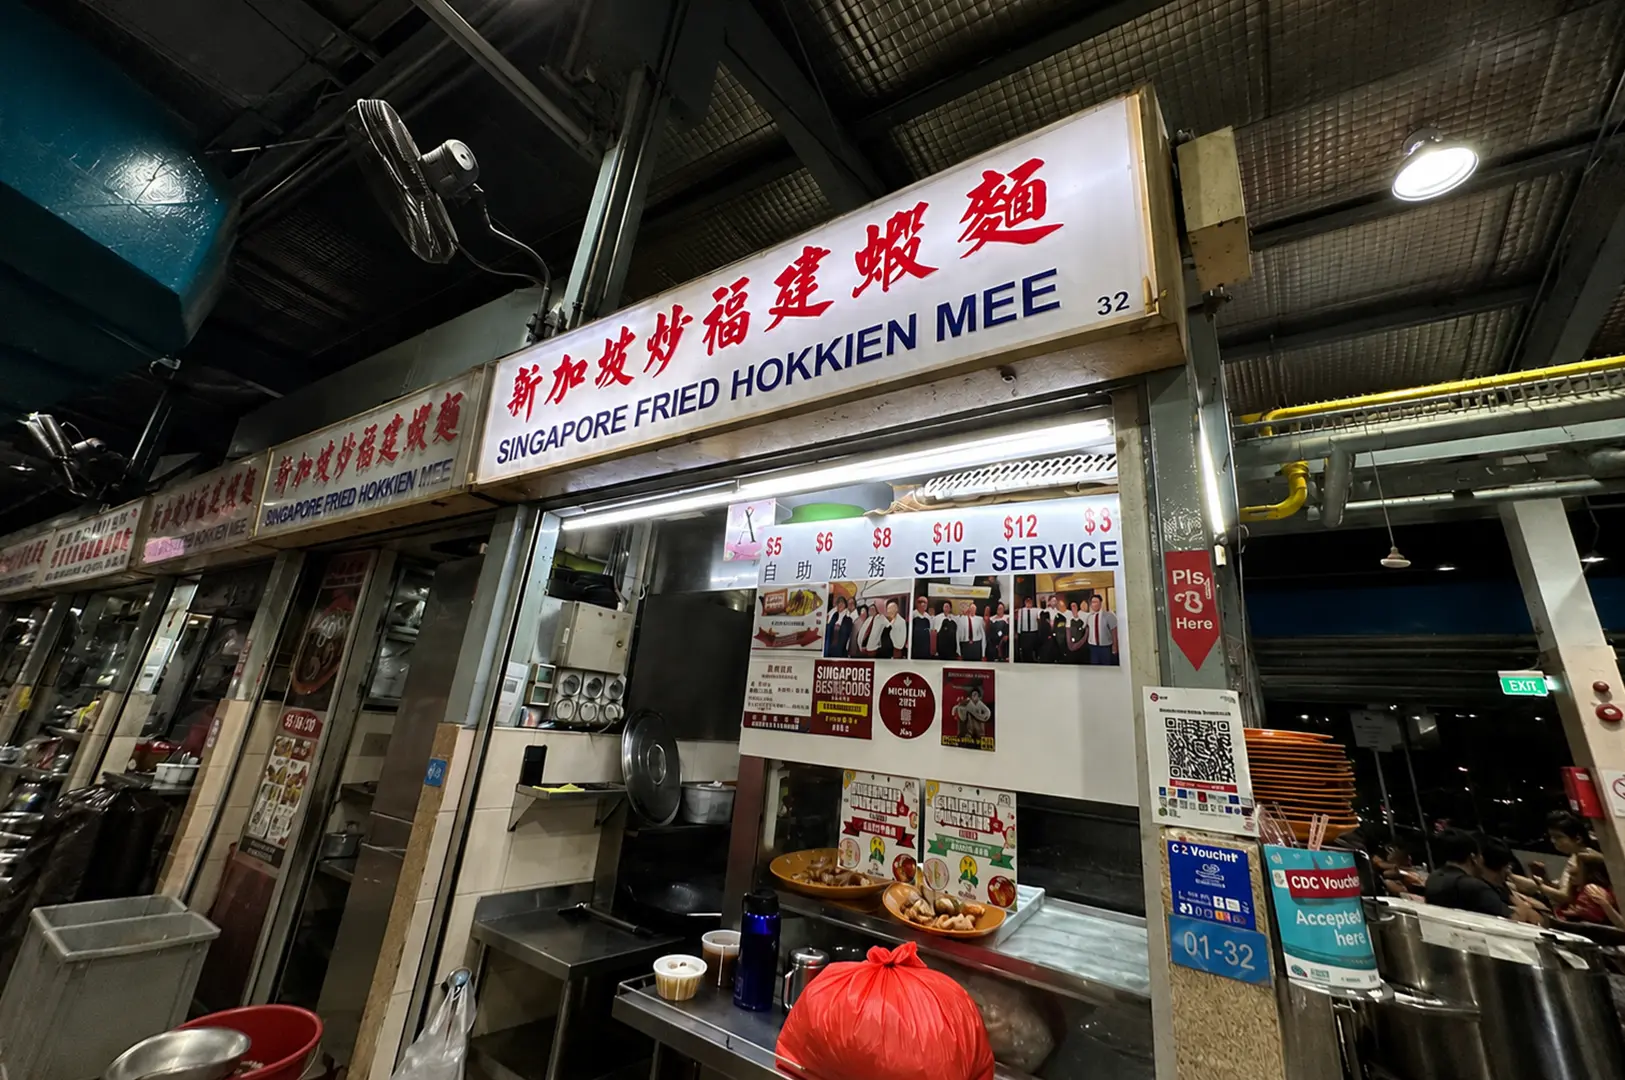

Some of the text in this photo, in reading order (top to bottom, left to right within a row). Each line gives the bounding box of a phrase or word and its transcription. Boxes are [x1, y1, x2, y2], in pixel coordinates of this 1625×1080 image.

[507, 157, 1064, 423] 新加坡炒福建蝦麵
[1097, 291, 1130, 316] 32
[497, 268, 1061, 464] SINGAPORE FRIED HOKKIEN MEE
[265, 496, 326, 526] SINGAPORE
[324, 487, 357, 512] FRIED
[358, 468, 418, 504] HOKKIEN
[766, 536, 782, 557] $5
[816, 532, 833, 554] $6
[873, 527, 892, 549] $8
[933, 521, 964, 545] $10
[1004, 514, 1037, 541] $12
[764, 555, 885, 583] 自助服務
[914, 541, 1119, 574] SELF SERVICE
[1172, 569, 1204, 585] Pls
[1176, 617, 1213, 629] Here
[817, 665, 871, 682] SINGAPORE
[888, 687, 926, 698] MICHELIN
[1509, 680, 1537, 691] EXIT
[1291, 875, 1320, 890] CDC
[1296, 908, 1362, 929] Accepted
[1334, 929, 1367, 946] here
[1183, 931, 1256, 971] 01-32
